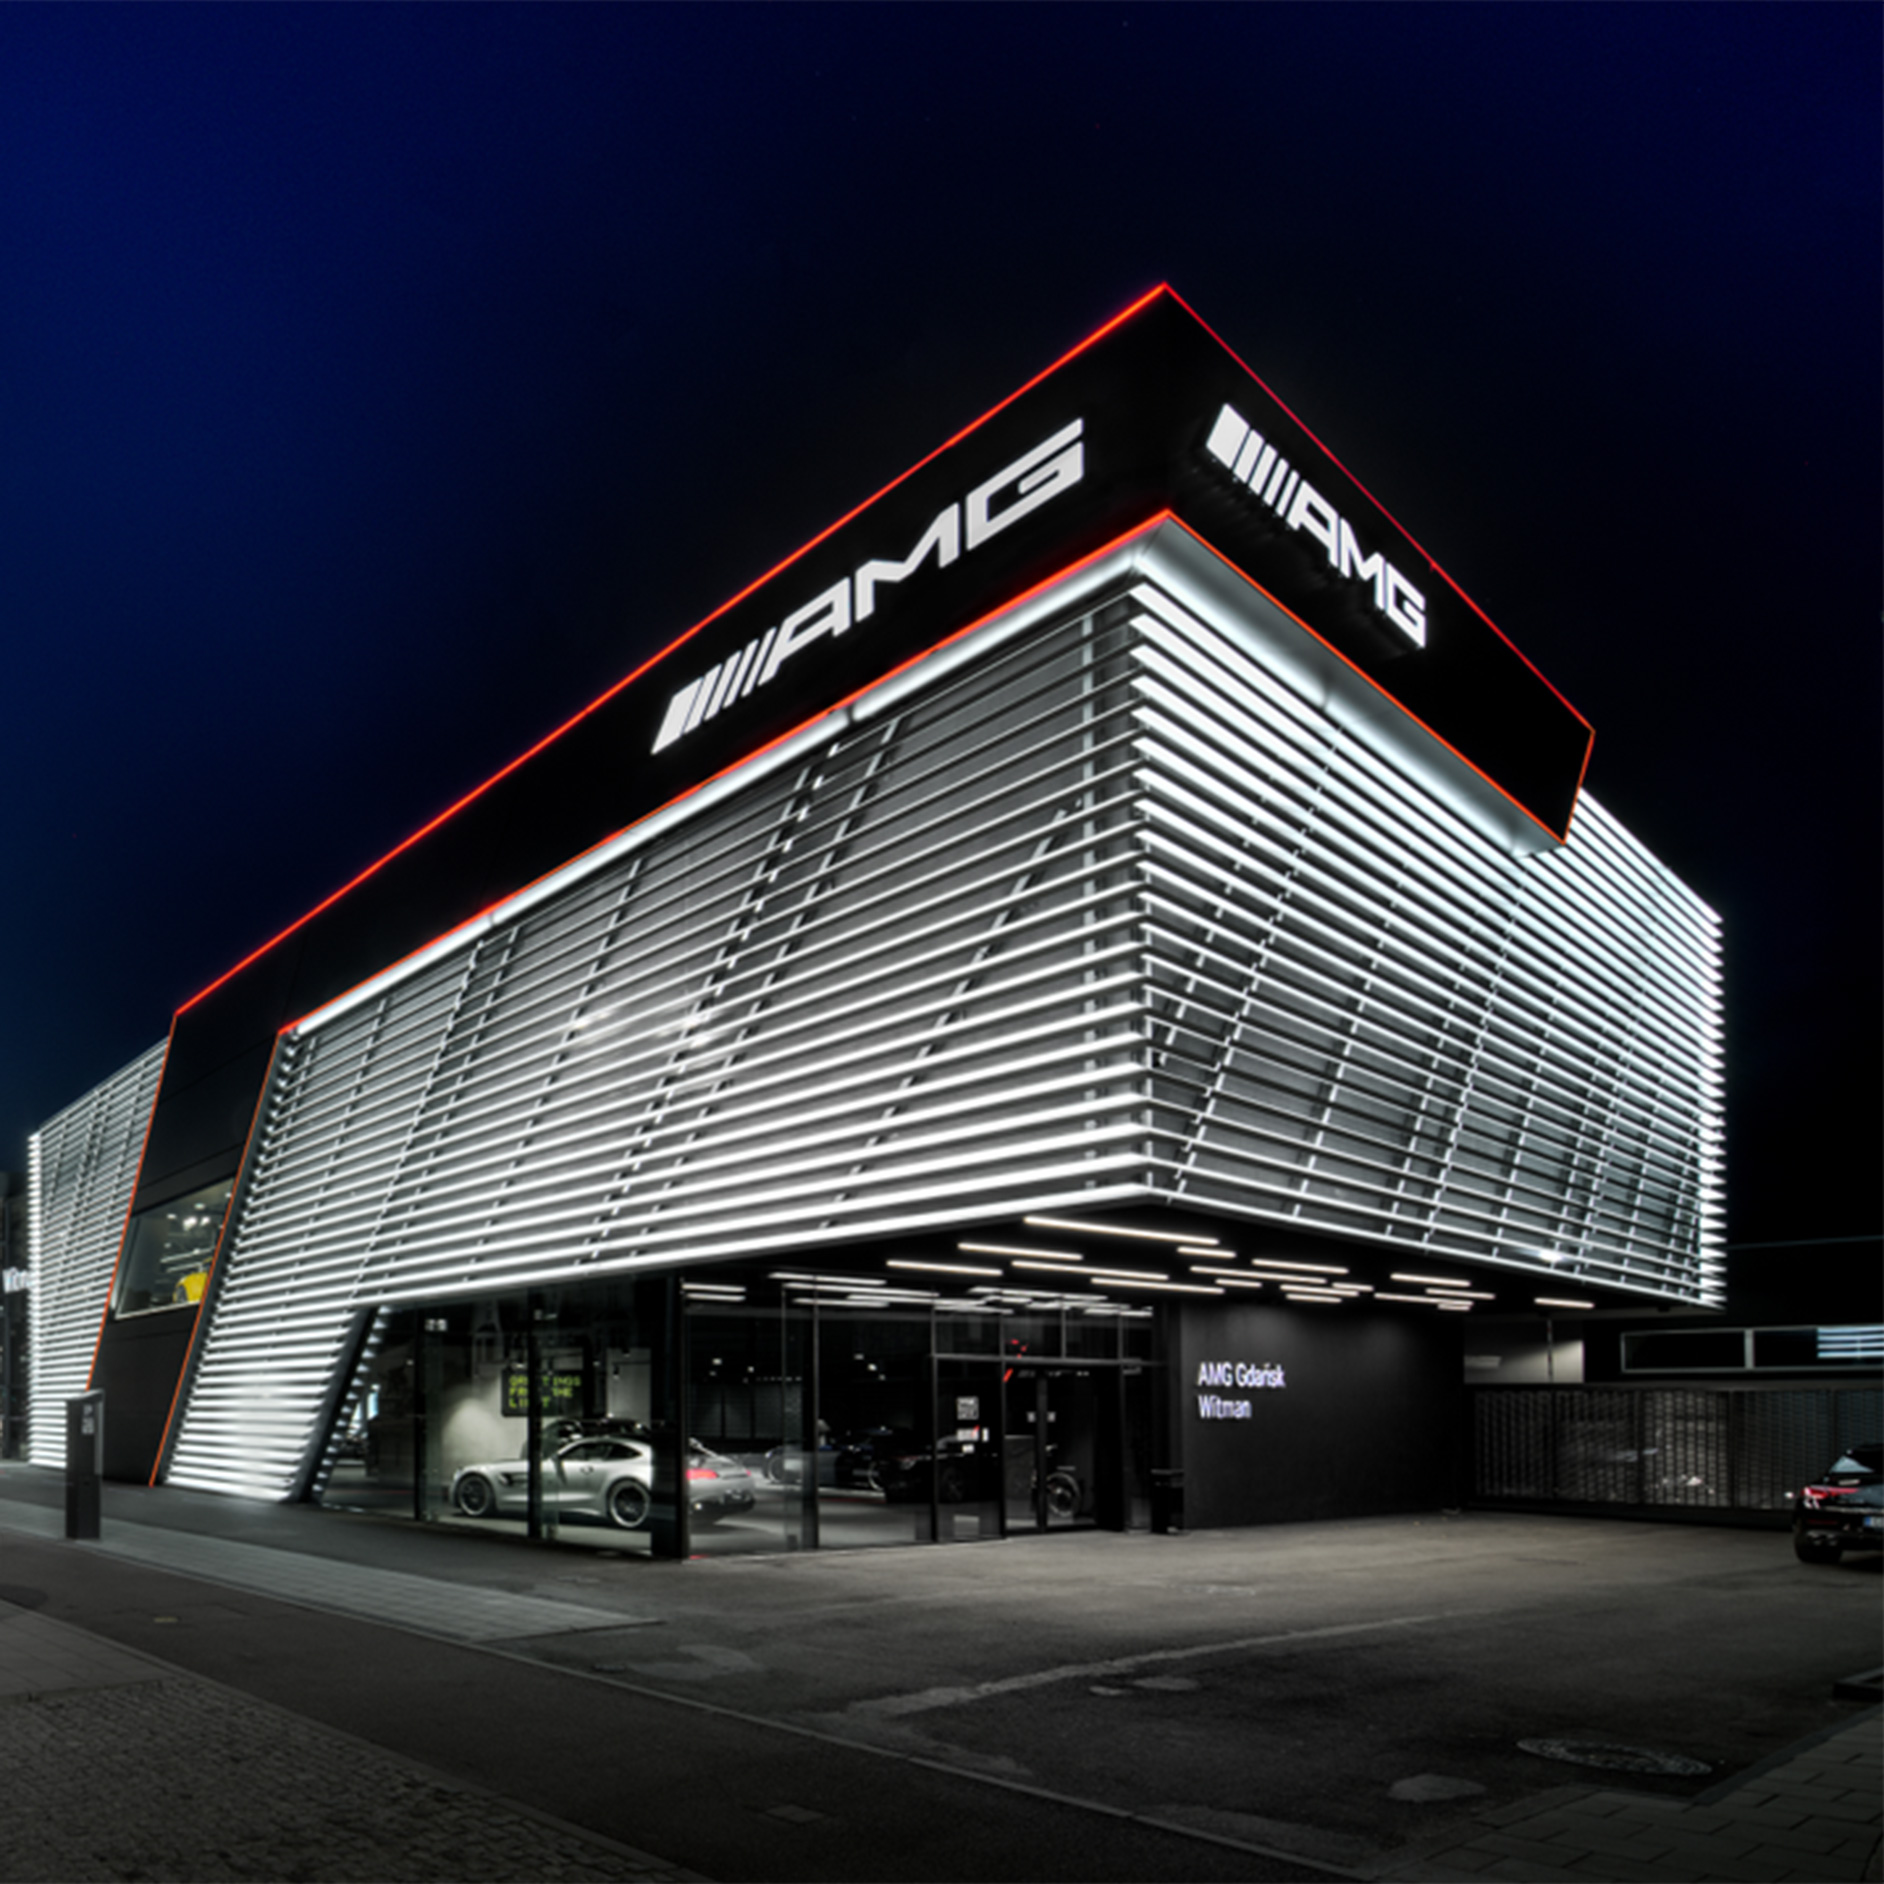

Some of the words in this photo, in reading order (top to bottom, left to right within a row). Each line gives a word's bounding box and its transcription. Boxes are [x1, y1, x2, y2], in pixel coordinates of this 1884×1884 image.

[758, 418, 1083, 686] AMG
[1286, 479, 1426, 649] AMG
[1198, 1362, 1234, 1387] AMG
[1198, 1395, 1252, 1419] Witman
